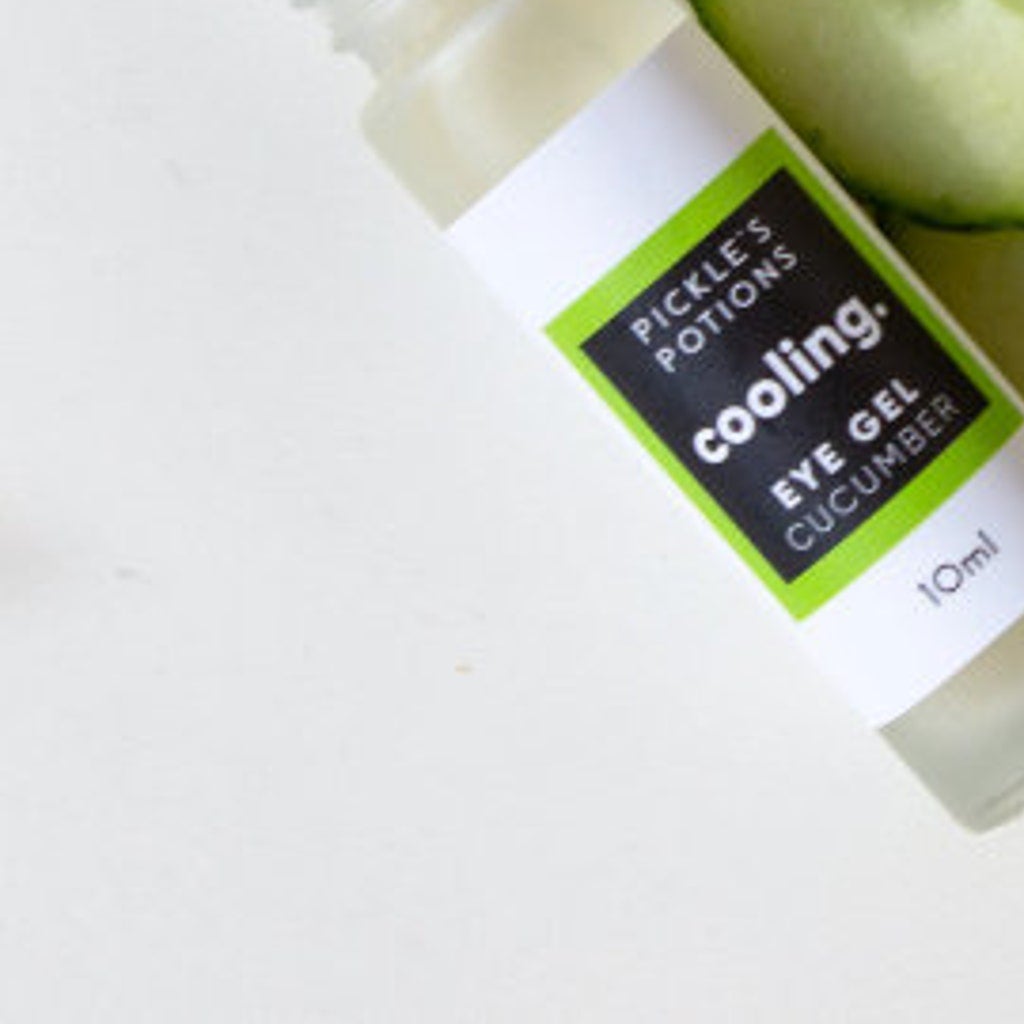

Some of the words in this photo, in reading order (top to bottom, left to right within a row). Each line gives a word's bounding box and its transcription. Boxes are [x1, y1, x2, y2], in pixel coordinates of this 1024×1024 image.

[629, 216, 772, 345] PICKLE'S
[655, 244, 798, 373] POTIONS
[693, 296, 888, 464] cooling.
[769, 442, 847, 510] EYE
[848, 378, 919, 442] GEL
[785, 394, 960, 551] CUCUMBER
[917, 529, 1001, 607] 10ml
